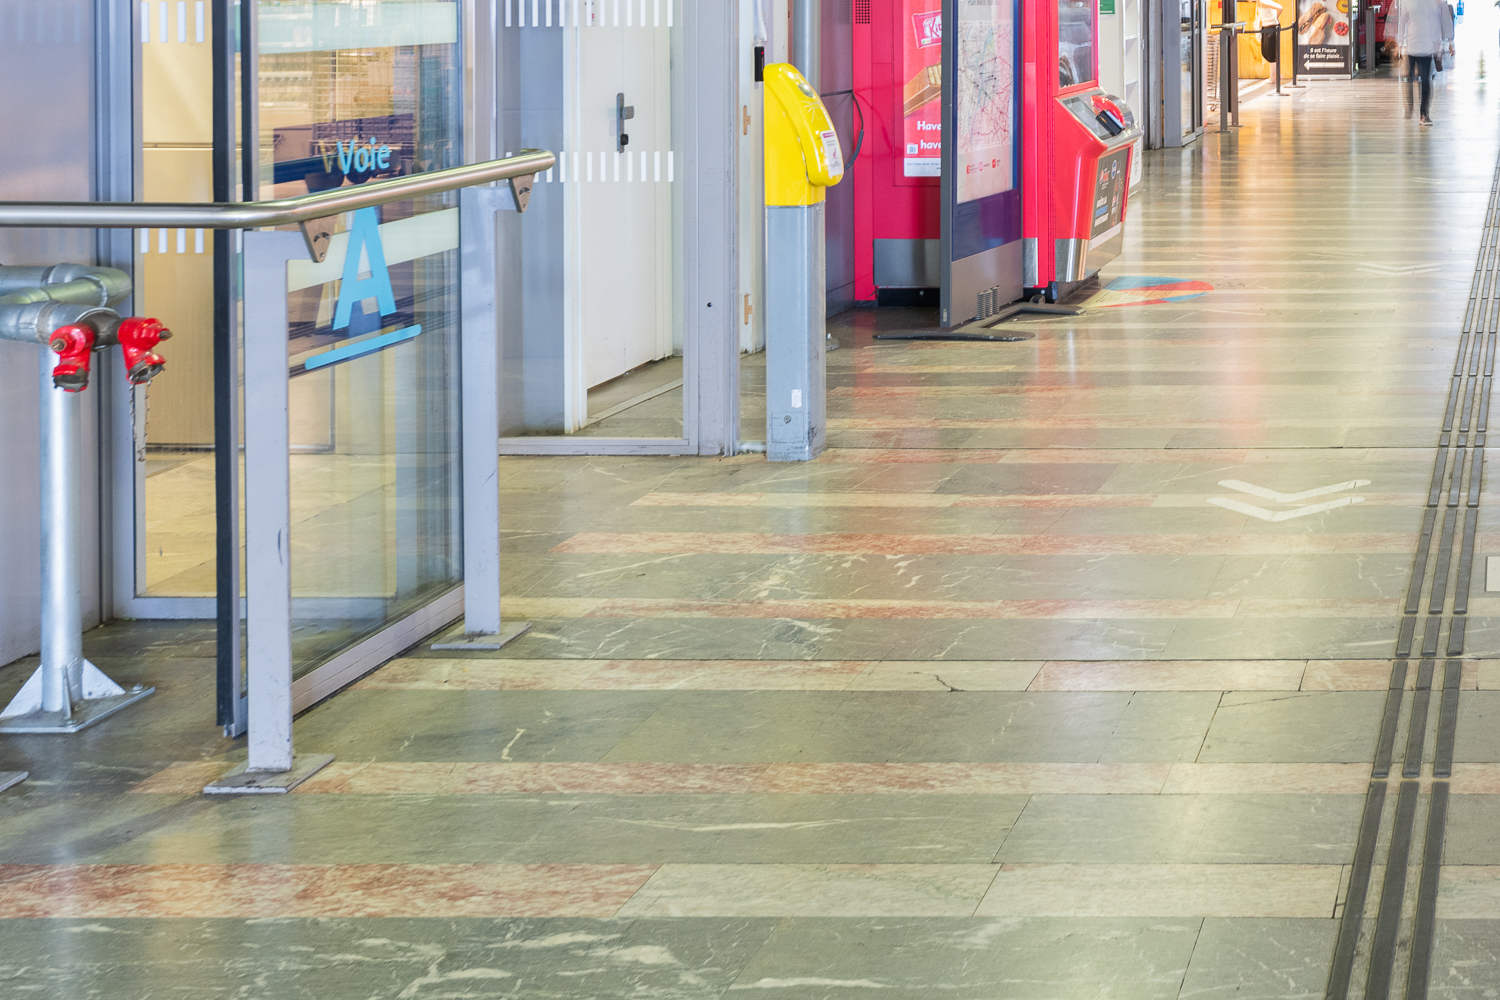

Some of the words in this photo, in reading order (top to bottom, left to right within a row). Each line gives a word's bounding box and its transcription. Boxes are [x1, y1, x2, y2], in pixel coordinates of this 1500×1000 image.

[917, 120, 942, 131] Have
[336, 137, 391, 174] Voie
[333, 206, 397, 331] A
